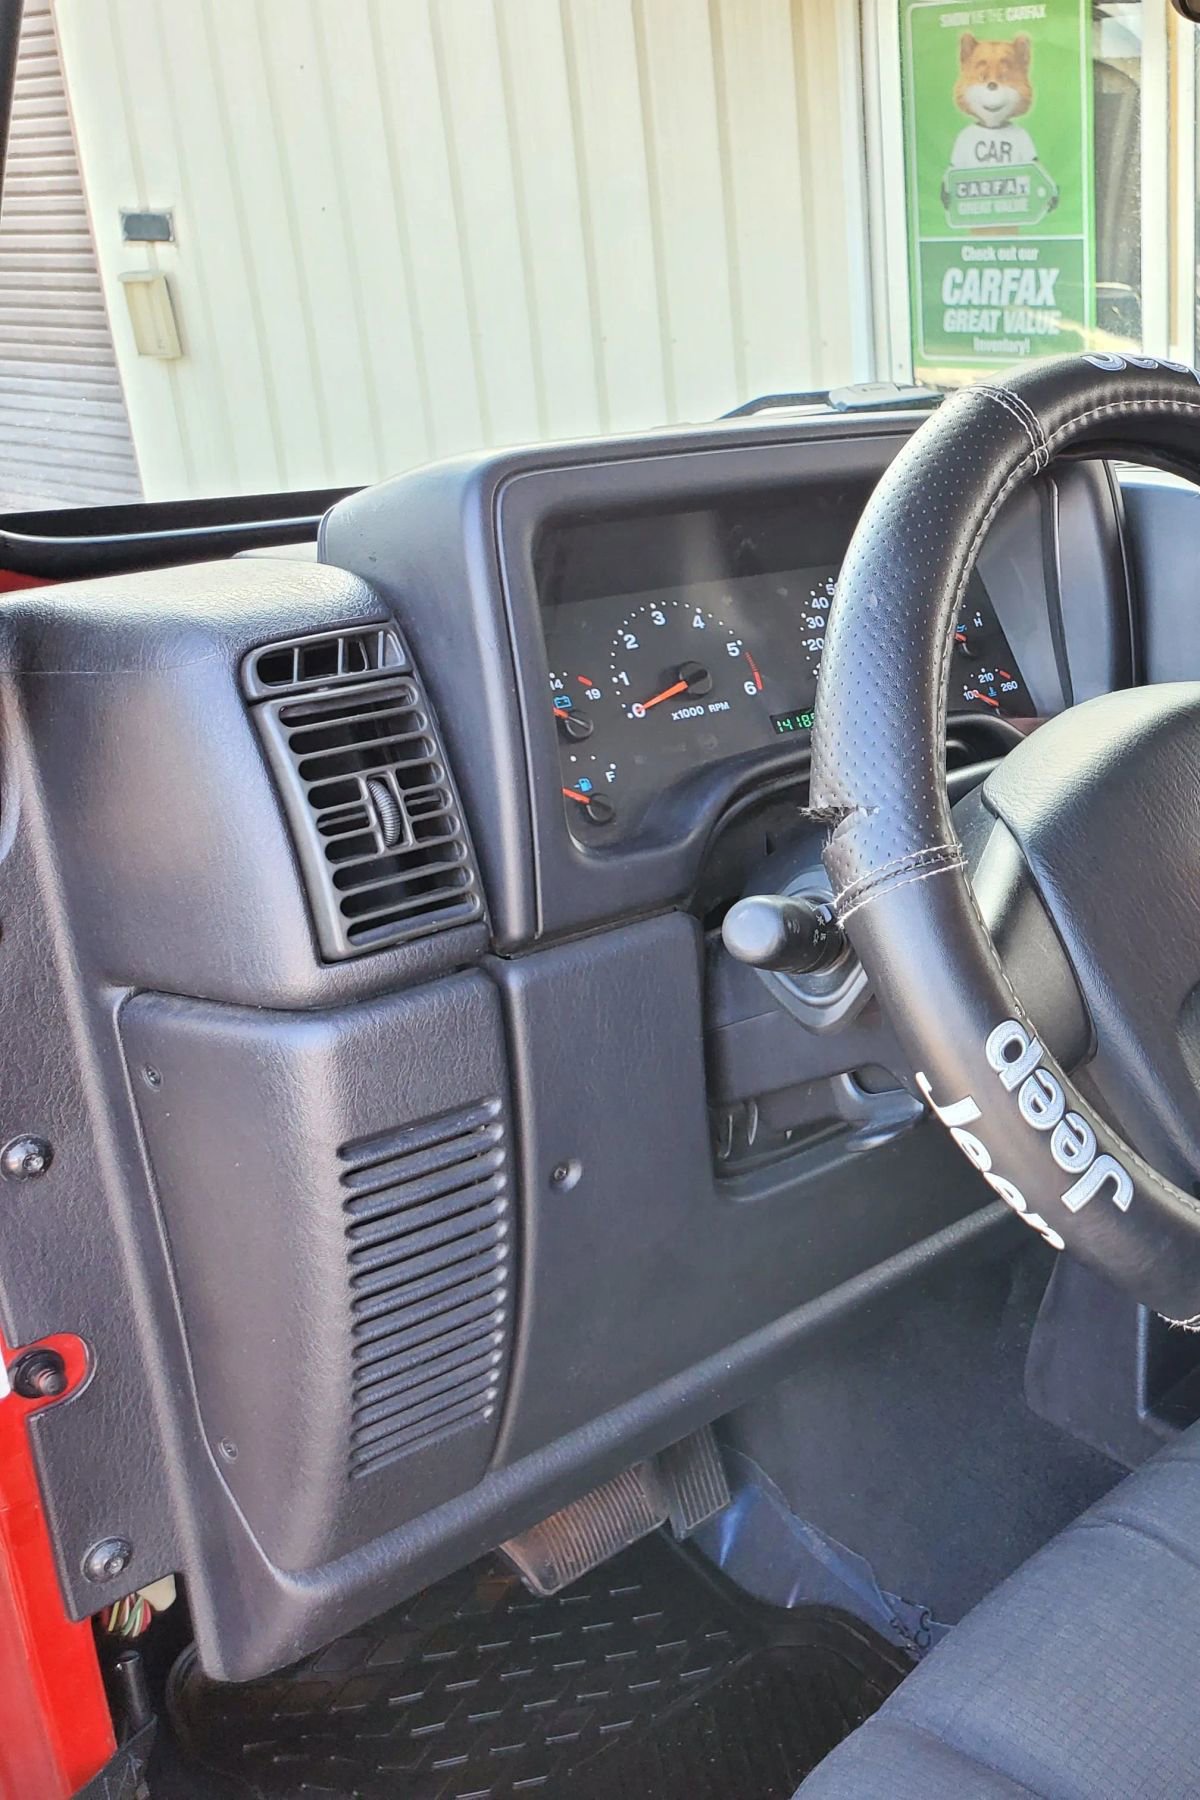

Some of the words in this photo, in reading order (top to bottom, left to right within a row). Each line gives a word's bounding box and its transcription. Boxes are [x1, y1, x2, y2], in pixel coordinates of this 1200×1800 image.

[975, 140, 1013, 163] CAR
[942, 267, 1060, 306] CARFAX
[943, 308, 1001, 333] GREAT
[1003, 309, 1062, 335] VALUE
[811, 596, 829, 609] 40
[650, 610, 666, 626] 3
[692, 614, 706, 629] 4
[806, 615, 825, 629] 30
[973, 617, 983, 627] H
[623, 634, 639, 650] 2
[726, 641, 741, 657] 5
[807, 637, 824, 651] 20
[618, 671, 630, 686] 1
[978, 672, 995, 684] 210
[743, 680, 757, 696] 6
[1000, 680, 1018, 692] 260
[585, 688, 601, 700] 19
[631, 702, 646, 718] 0
[671, 705, 705, 721] x1000
[708, 701, 731, 713] RPM
[605, 770, 616, 783] F
[985, 1018, 1135, 1213] Jeep
